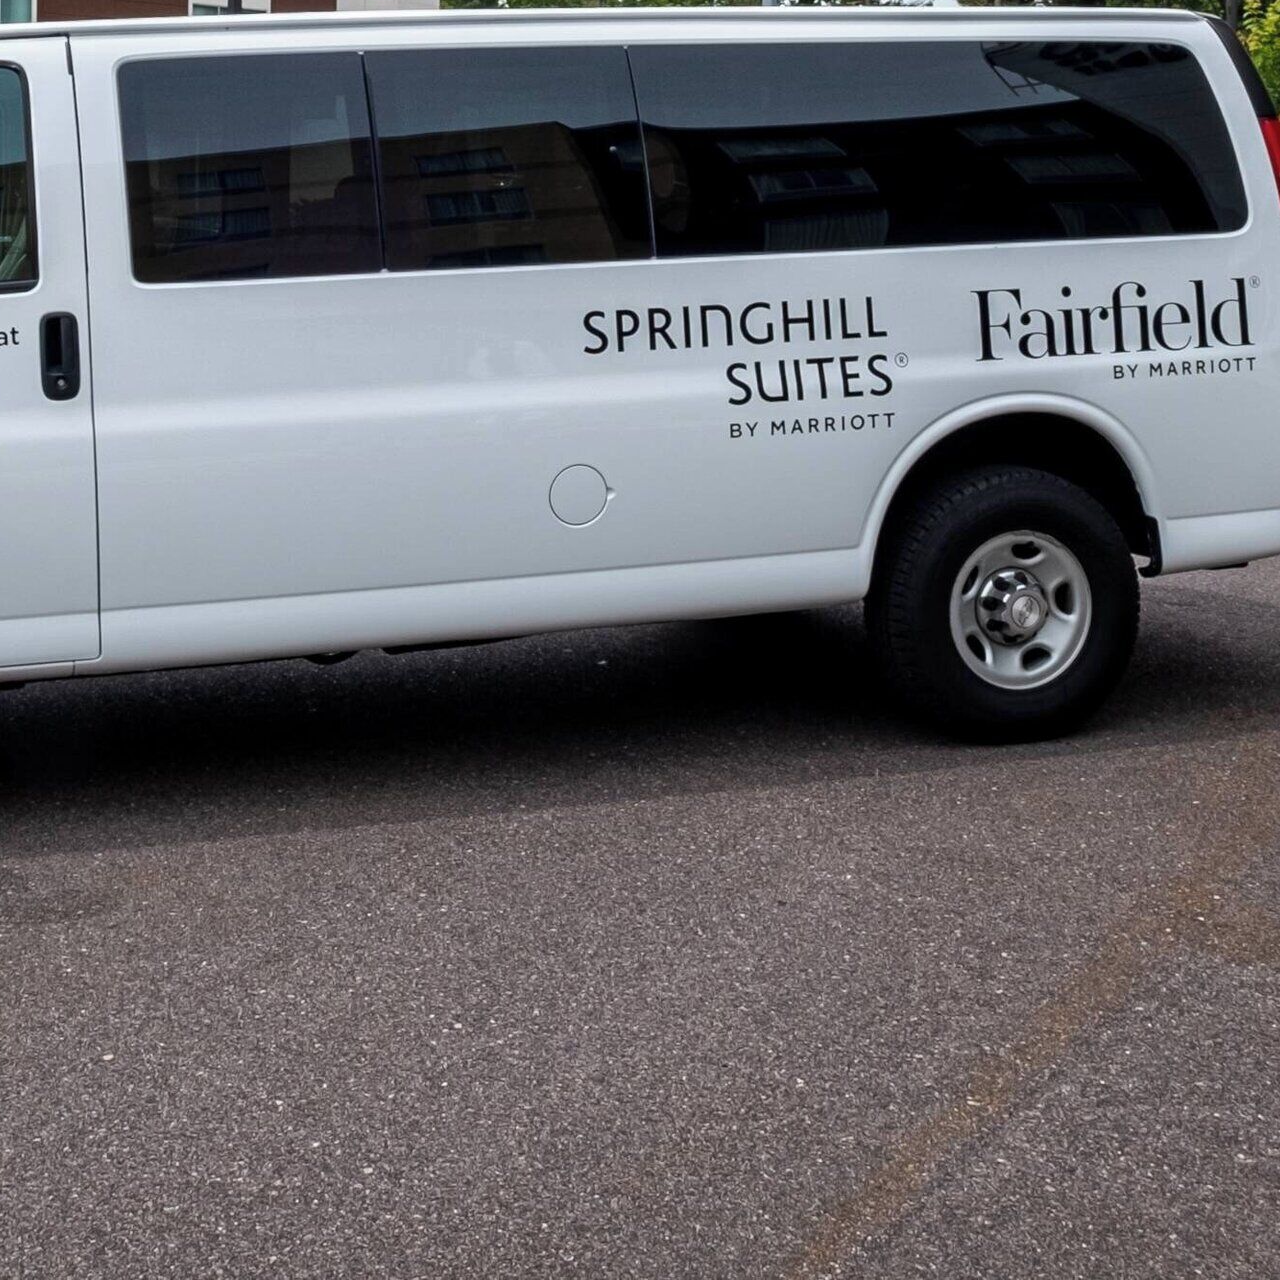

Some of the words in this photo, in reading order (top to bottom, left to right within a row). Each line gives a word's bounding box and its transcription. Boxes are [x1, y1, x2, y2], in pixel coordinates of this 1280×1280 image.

[582, 295, 888, 356] SPRINGHILL
[1112, 363, 1140, 380] BY
[1149, 356, 1257, 378] MARRIOTT
[729, 421, 759, 439] BY
[770, 412, 896, 437] MARRIOTT
